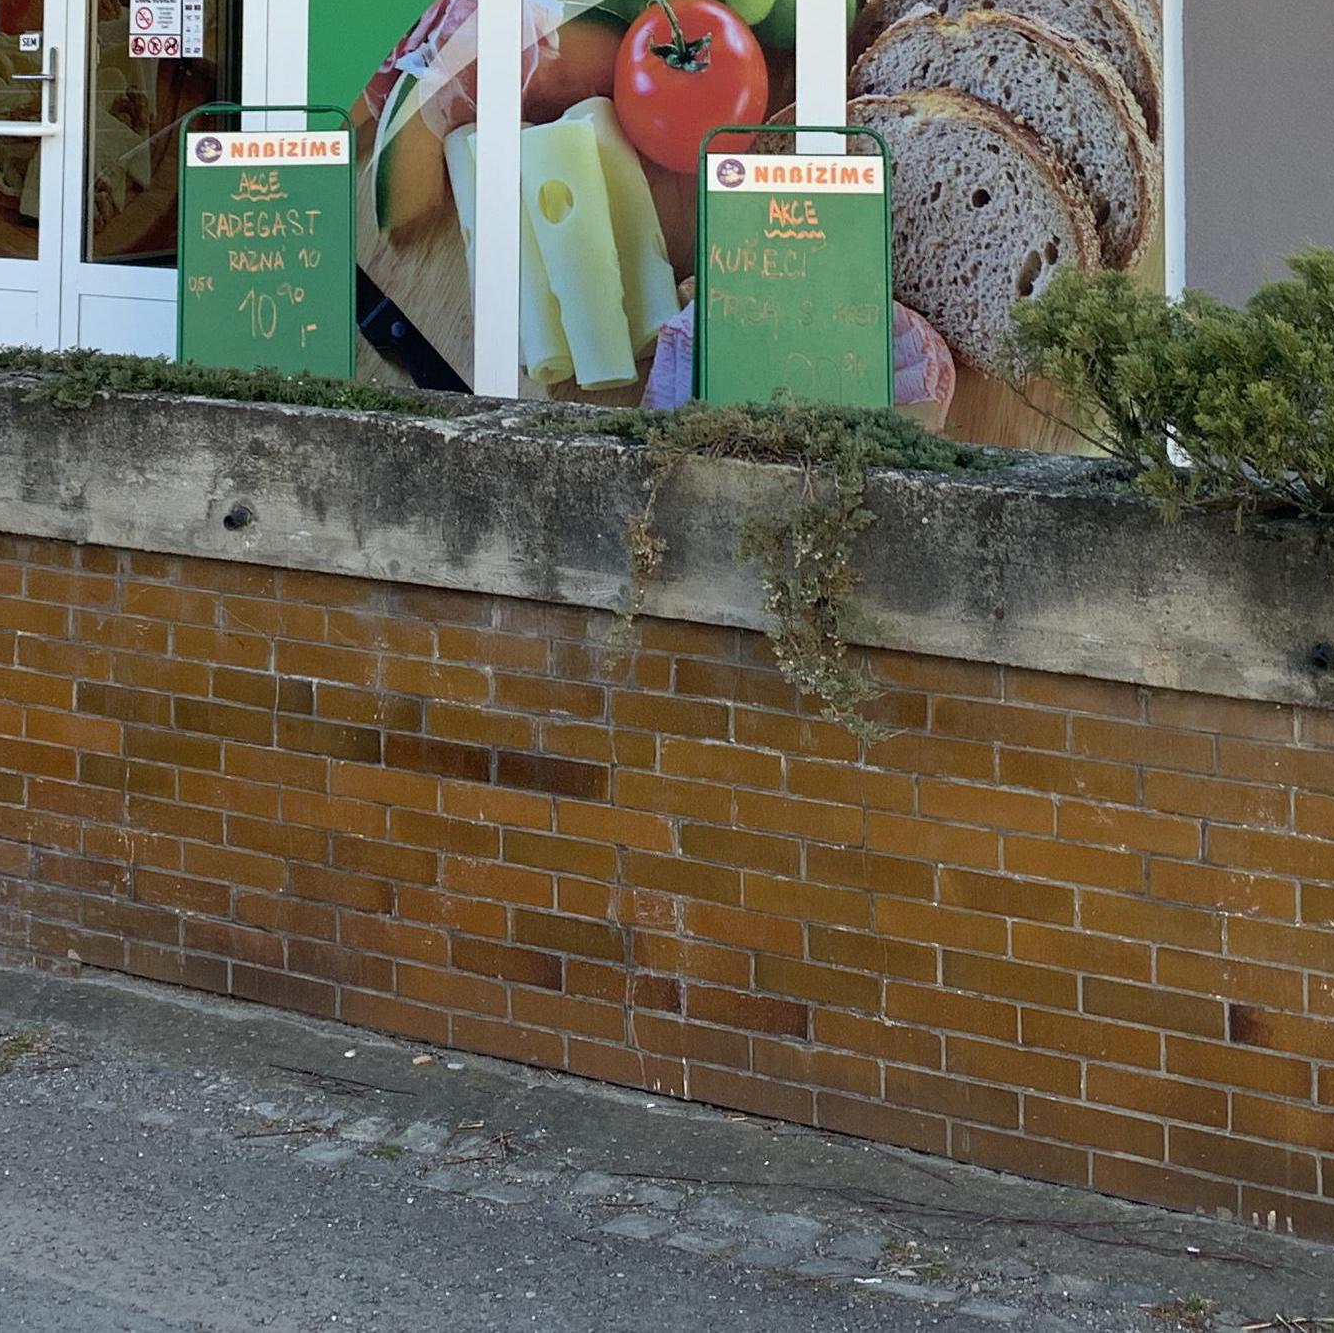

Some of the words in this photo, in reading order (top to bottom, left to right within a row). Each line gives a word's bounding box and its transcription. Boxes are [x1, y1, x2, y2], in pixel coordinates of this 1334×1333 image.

[21, 36, 38, 48] SEM
[230, 137, 342, 159] NABÍZÍME
[238, 170, 280, 194] AKCE
[753, 162, 875, 185] NABÍZÍME
[768, 197, 819, 227] AKCE
[200, 208, 322, 240] RADEGAST
[299, 246, 322, 269] 10
